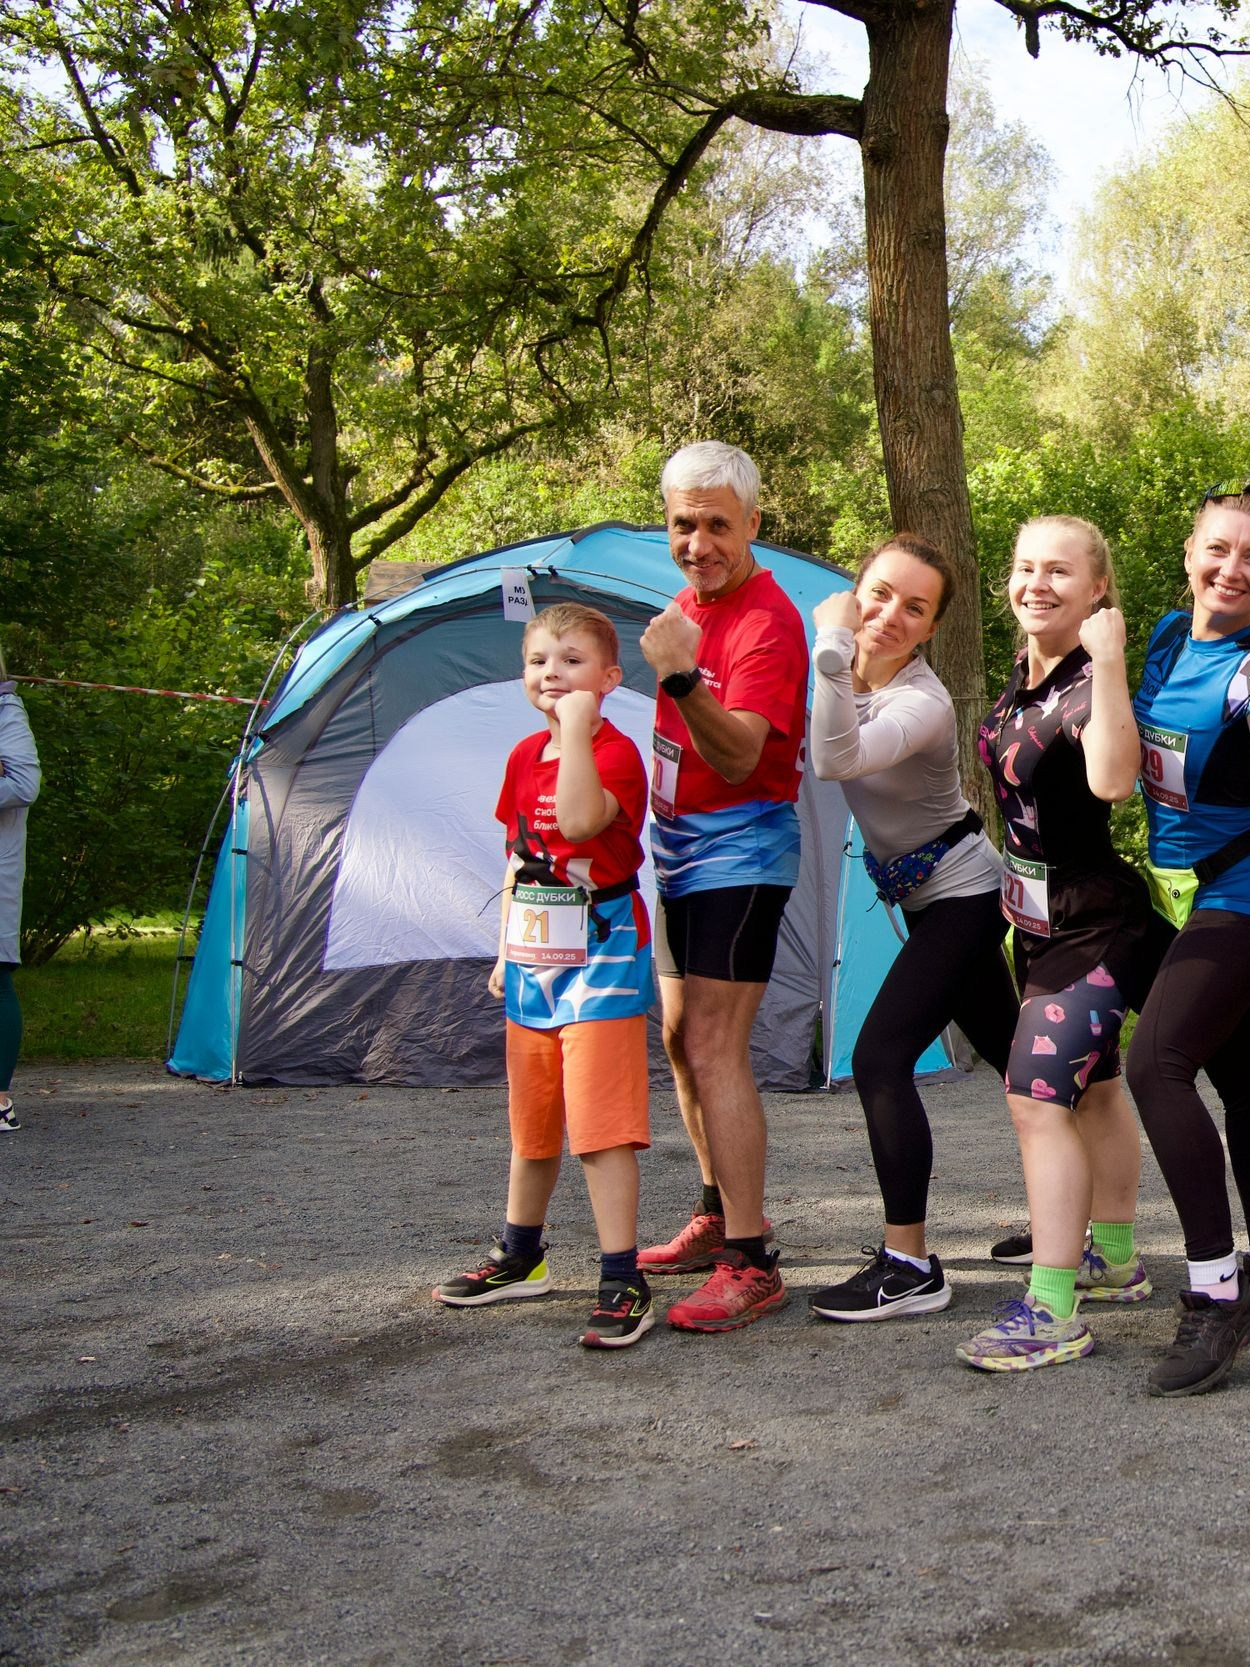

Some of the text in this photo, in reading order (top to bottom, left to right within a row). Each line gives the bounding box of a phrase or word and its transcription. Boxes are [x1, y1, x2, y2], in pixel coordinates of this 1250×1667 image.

[1145, 730, 1177, 747] ДУБКИ
[515, 889, 577, 903] РОСС ДУБКИ
[523, 908, 549, 943] 21
[541, 952, 577, 961] 14.09.25
